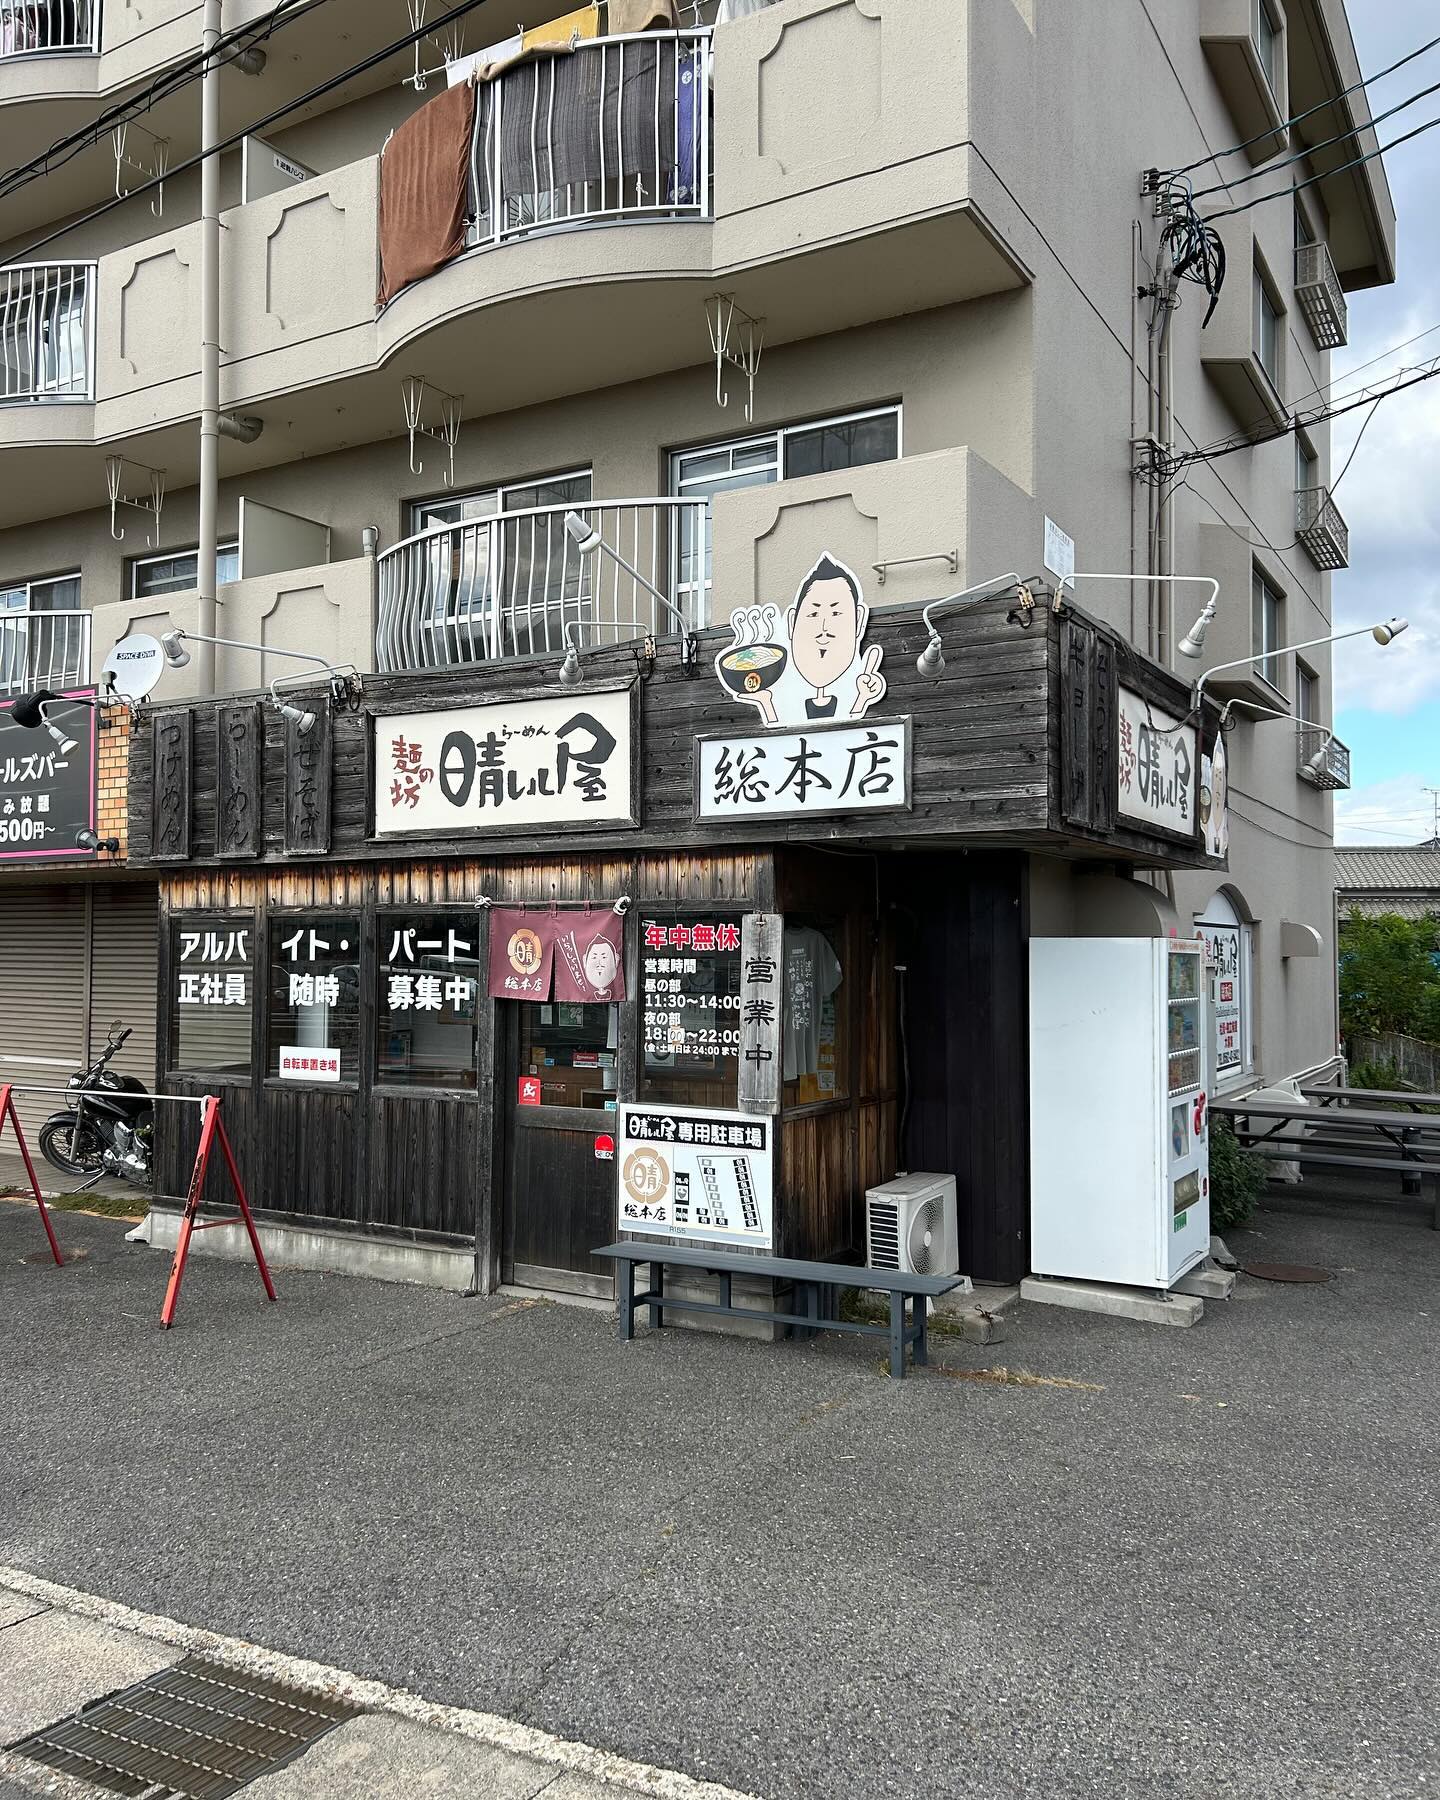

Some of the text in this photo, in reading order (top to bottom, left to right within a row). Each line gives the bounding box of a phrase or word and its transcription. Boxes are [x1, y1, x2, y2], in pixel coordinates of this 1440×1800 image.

[118, 652, 140, 660] SPACE
[502, 725, 550, 739] らーめん
[227, 713, 249, 846] らーめん
[294, 708, 320, 841] ぜそば
[390, 735, 434, 809] 麺の坊
[713, 731, 899, 805] 総本店
[160, 724, 182, 846] つけめん
[3, 794, 50, 815] み放題
[179, 930, 248, 962] アルバ
[388, 928, 471, 963] パート
[644, 923, 740, 951] 年中無休
[516, 940, 533, 964] 晴
[644, 958, 697, 974] 営業時間
[178, 973, 471, 1012] 正社員 随時 募集中
[504, 976, 543, 992] 総本店
[644, 978, 681, 993] 昼の部
[644, 1011, 681, 1026] 夜の部
[743, 956, 777, 1071] 営業中
[692, 1045, 720, 1056] 24:00
[282, 1057, 337, 1073] 自転車置き場
[677, 1121, 762, 1148] 専用駐車場
[633, 1163, 657, 1190] 晴
[624, 1203, 667, 1221] 総本店
